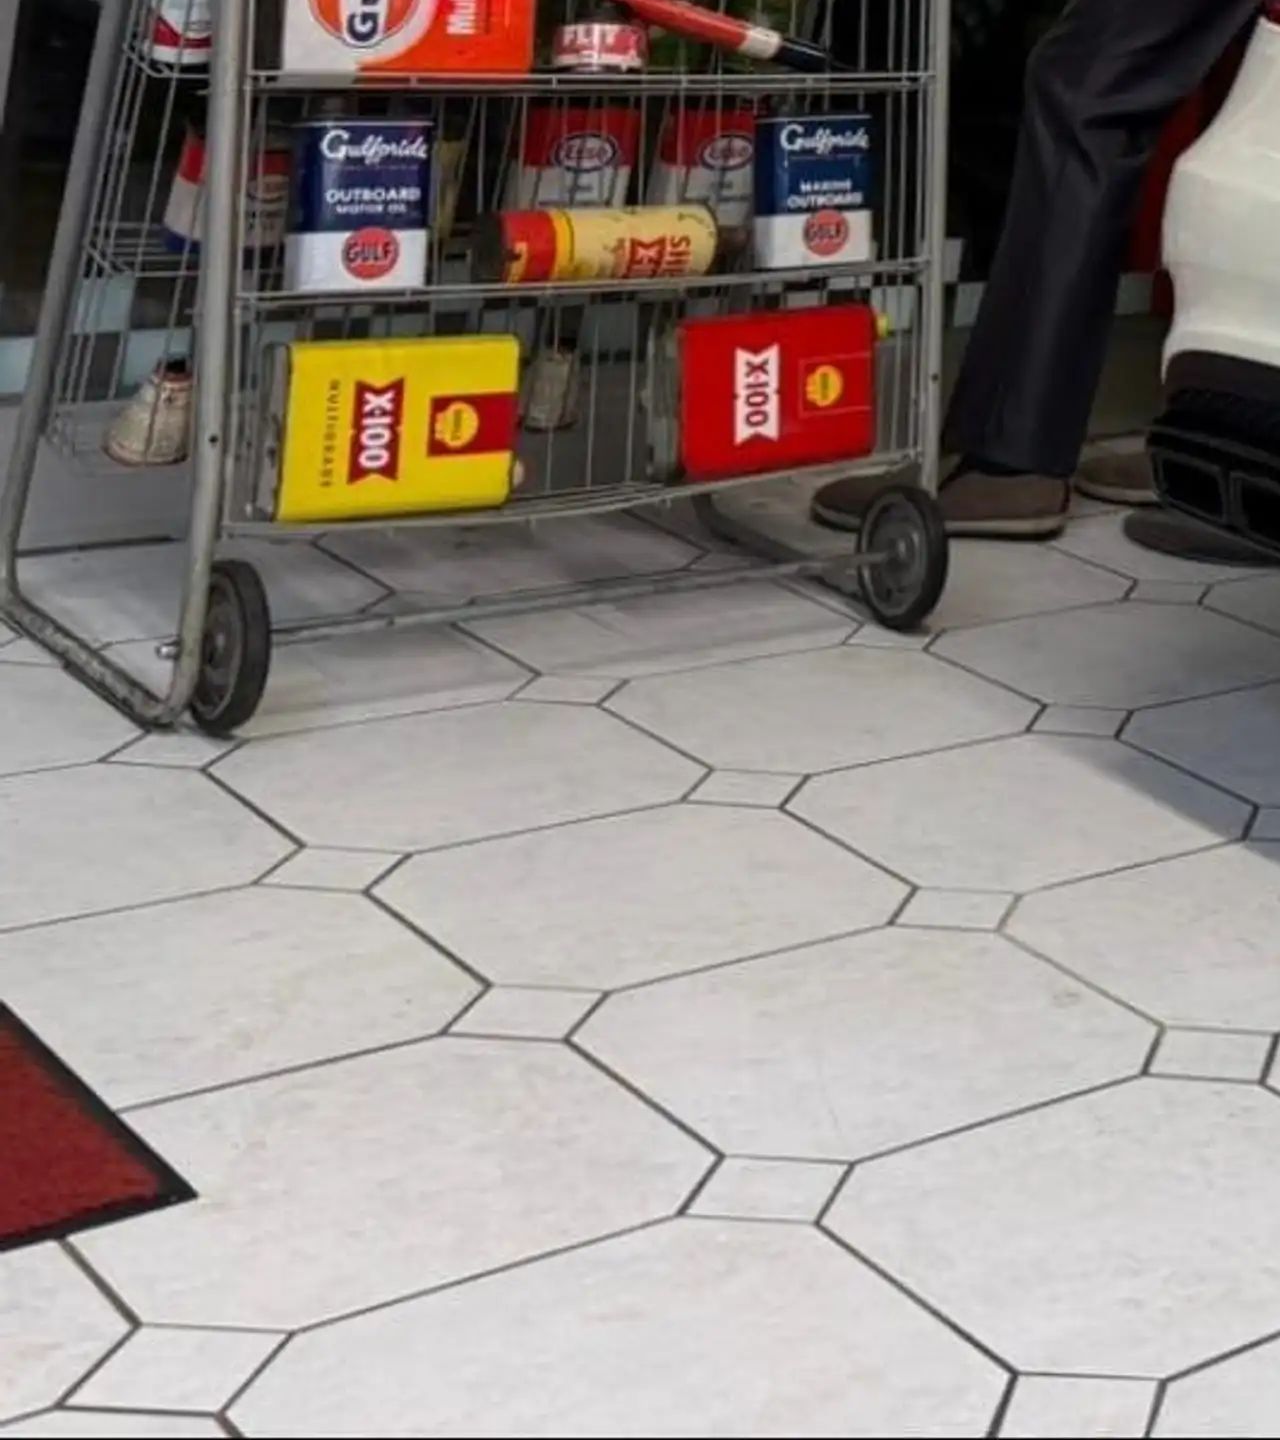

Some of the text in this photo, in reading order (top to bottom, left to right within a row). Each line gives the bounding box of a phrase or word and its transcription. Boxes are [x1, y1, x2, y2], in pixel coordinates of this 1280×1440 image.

[320, 129, 429, 166] Gulfpride
[779, 123, 871, 156] Gulfpride
[325, 186, 423, 205] OUTBOARD
[347, 239, 395, 263] GULF
